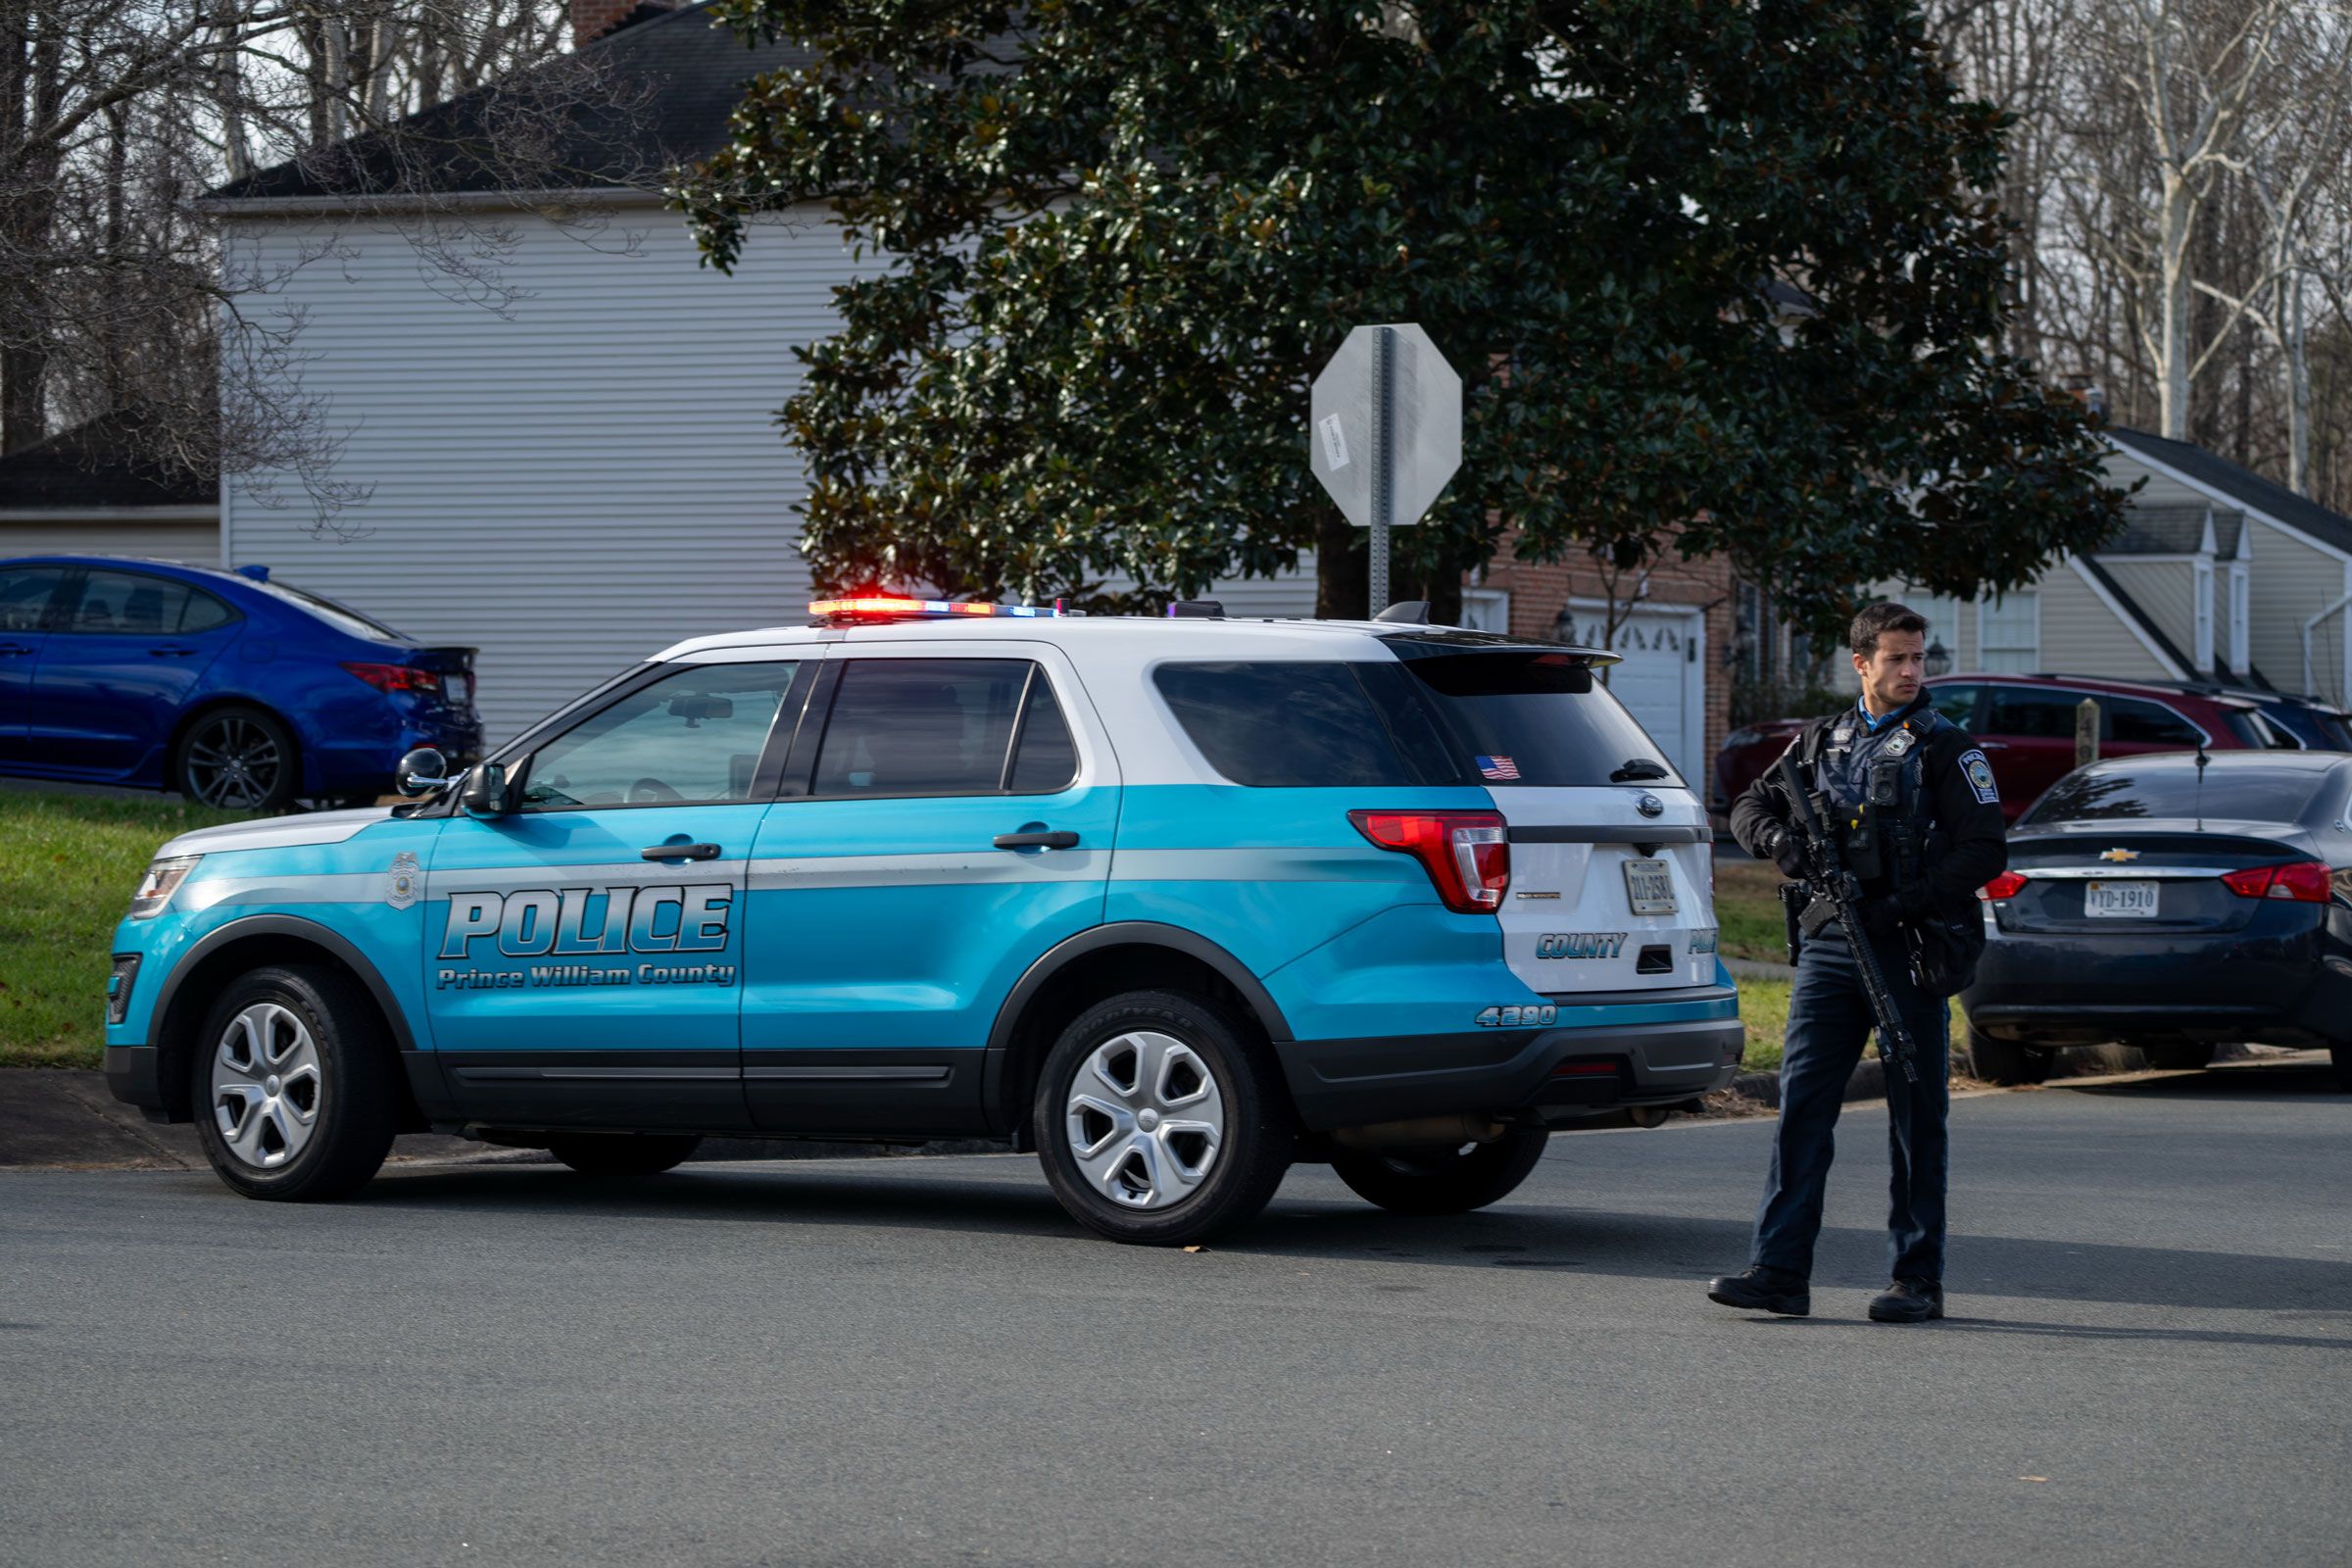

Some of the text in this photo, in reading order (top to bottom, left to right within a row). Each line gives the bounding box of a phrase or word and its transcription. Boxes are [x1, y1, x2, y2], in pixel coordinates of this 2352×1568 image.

[2089, 890, 2154, 908] VYD-1910
[436, 883, 733, 960] POLICE
[1536, 932, 1628, 959] COUNTY
[436, 962, 736, 991] Prince William County
[1475, 1004, 1558, 1027] 4290
